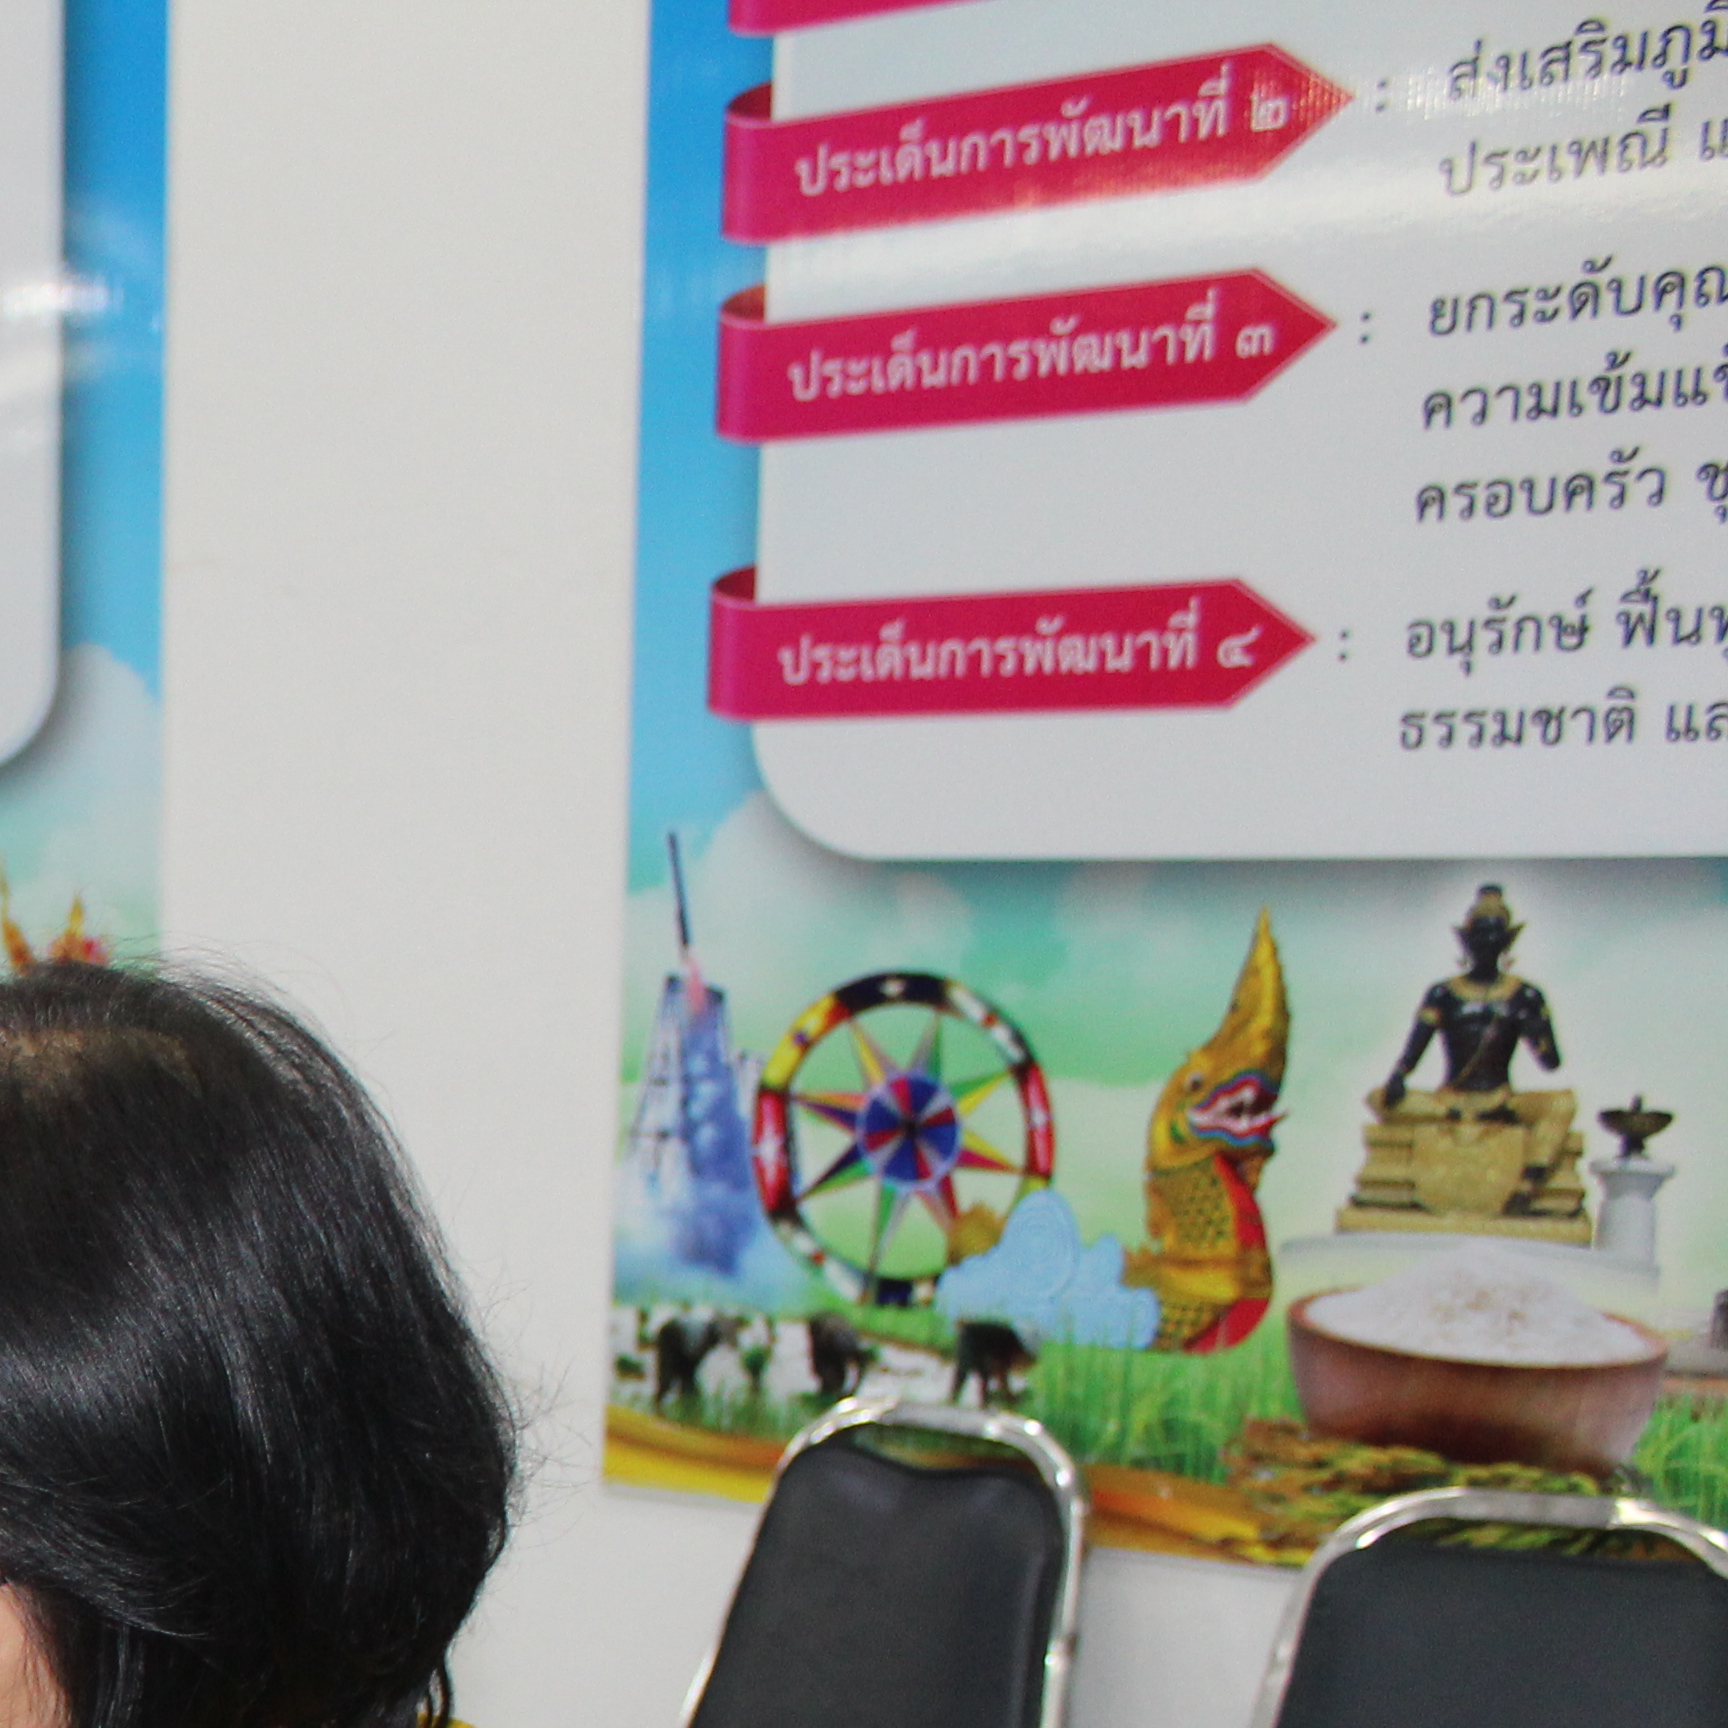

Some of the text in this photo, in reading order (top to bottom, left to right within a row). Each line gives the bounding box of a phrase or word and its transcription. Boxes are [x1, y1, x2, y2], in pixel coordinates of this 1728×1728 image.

[796, 62, 1231, 196] ประเด็นการพัฒนาที่
[1439, 101, 1672, 196] ประเพณี
[787, 287, 1221, 402] ประเด็นการพัฒนาที่
[1235, 321, 1276, 359] ๓
[1414, 446, 1668, 523] ครอบครัว
[777, 596, 1202, 686] ประเด็นการพัฒนาที่
[1406, 586, 1595, 678] อนุรักษ์
[1399, 685, 1639, 751] ธรรมชาติ
